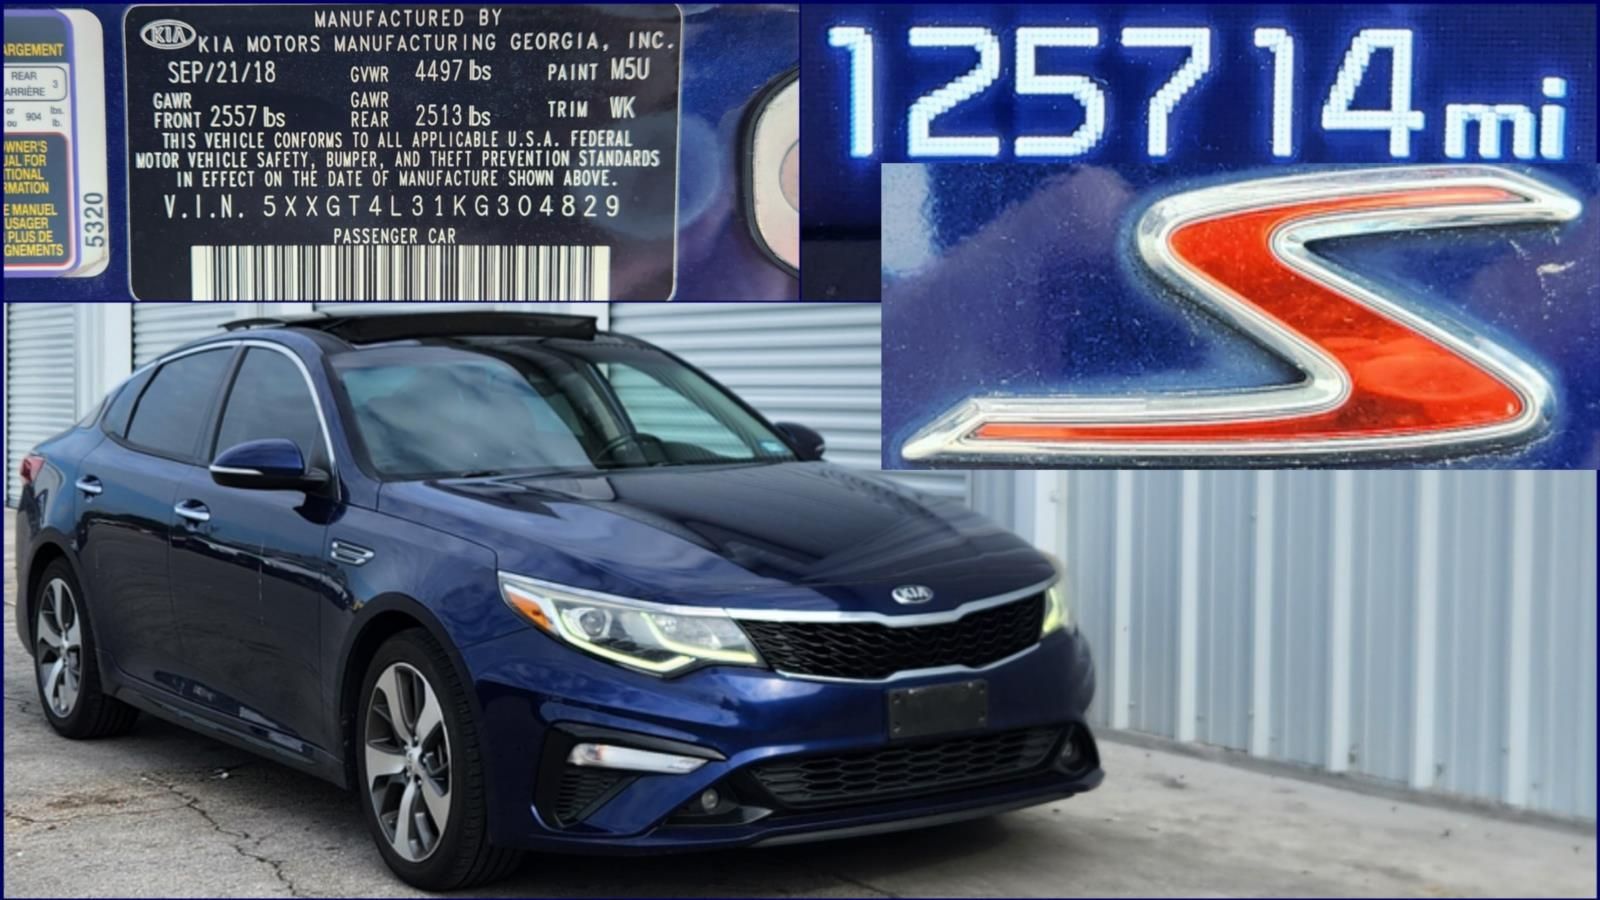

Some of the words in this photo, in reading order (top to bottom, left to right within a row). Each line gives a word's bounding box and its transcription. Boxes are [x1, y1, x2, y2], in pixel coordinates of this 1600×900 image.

[314, 9, 464, 28] MANUFACTURED
[479, 8, 502, 26] BY
[151, 26, 187, 44] KIA
[198, 35, 234, 53] KIA
[246, 35, 321, 53] MOTORS
[334, 33, 497, 52] MANUFACTURING
[510, 32, 609, 52] GEORGIA,
[628, 31, 674, 49] INC.
[11, 71, 38, 81] REAR
[168, 60, 276, 84] SEP/21/18
[350, 65, 389, 83] GVWR
[415, 59, 463, 82] 4497
[469, 59, 492, 81] lbs
[547, 63, 599, 81] PAINT
[610, 57, 650, 81] M5U
[52, 79, 59, 89] 3
[828, 26, 1425, 158] 125714
[1444, 76, 1566, 160] mi
[152, 92, 192, 110] GAWR
[350, 91, 389, 109] GAWR
[547, 100, 588, 118] TRIM
[609, 95, 637, 119] WK
[25, 112, 42, 121] 904
[153, 111, 202, 129] FRONT
[210, 104, 258, 128] 2557
[263, 106, 286, 128] lbs
[350, 111, 389, 128] REAR
[415, 103, 463, 127] 2513
[468, 105, 492, 127] lbs
[161, 132, 197, 149] THIS
[204, 131, 265, 149] VEHICLE
[274, 131, 343, 149] CONFORMS
[352, 131, 369, 148] TO
[377, 131, 403, 148] ALL
[412, 131, 499, 148] APPLICABLE
[508, 130, 560, 147] U.S.A.
[570, 130, 633, 147] FEDERAL
[24, 154, 48, 167] FOR
[135, 151, 179, 169] MOTOR
[187, 151, 248, 168] VEHICLE
[257, 151, 316, 169] SAFETY,
[326, 151, 385, 169] BUMPER,
[394, 150, 421, 168] AND
[430, 150, 472, 168] THEFT
[481, 150, 570, 167] PREVENTION
[578, 149, 660, 167] STANDARDS
[176, 171, 193, 188] IN
[201, 170, 255, 187] EFFECT
[264, 170, 282, 187] ON
[292, 170, 318, 187] THE
[327, 170, 363, 187] DATE
[372, 170, 390, 187] OF
[399, 169, 499, 187] MANUFACTURE
[508, 169, 554, 187] SHOWN
[563, 169, 618, 187] ABOVE.
[12, 203, 59, 216] MANUEL
[164, 193, 245, 219] V.I.N.
[263, 194, 620, 217] 5XXGT4L31KG304829
[83, 192, 106, 248] 5320
[8, 230, 37, 244] PLUS
[38, 230, 54, 243] DE
[333, 228, 418, 244] PASSENGER
[428, 228, 456, 244] CAR
